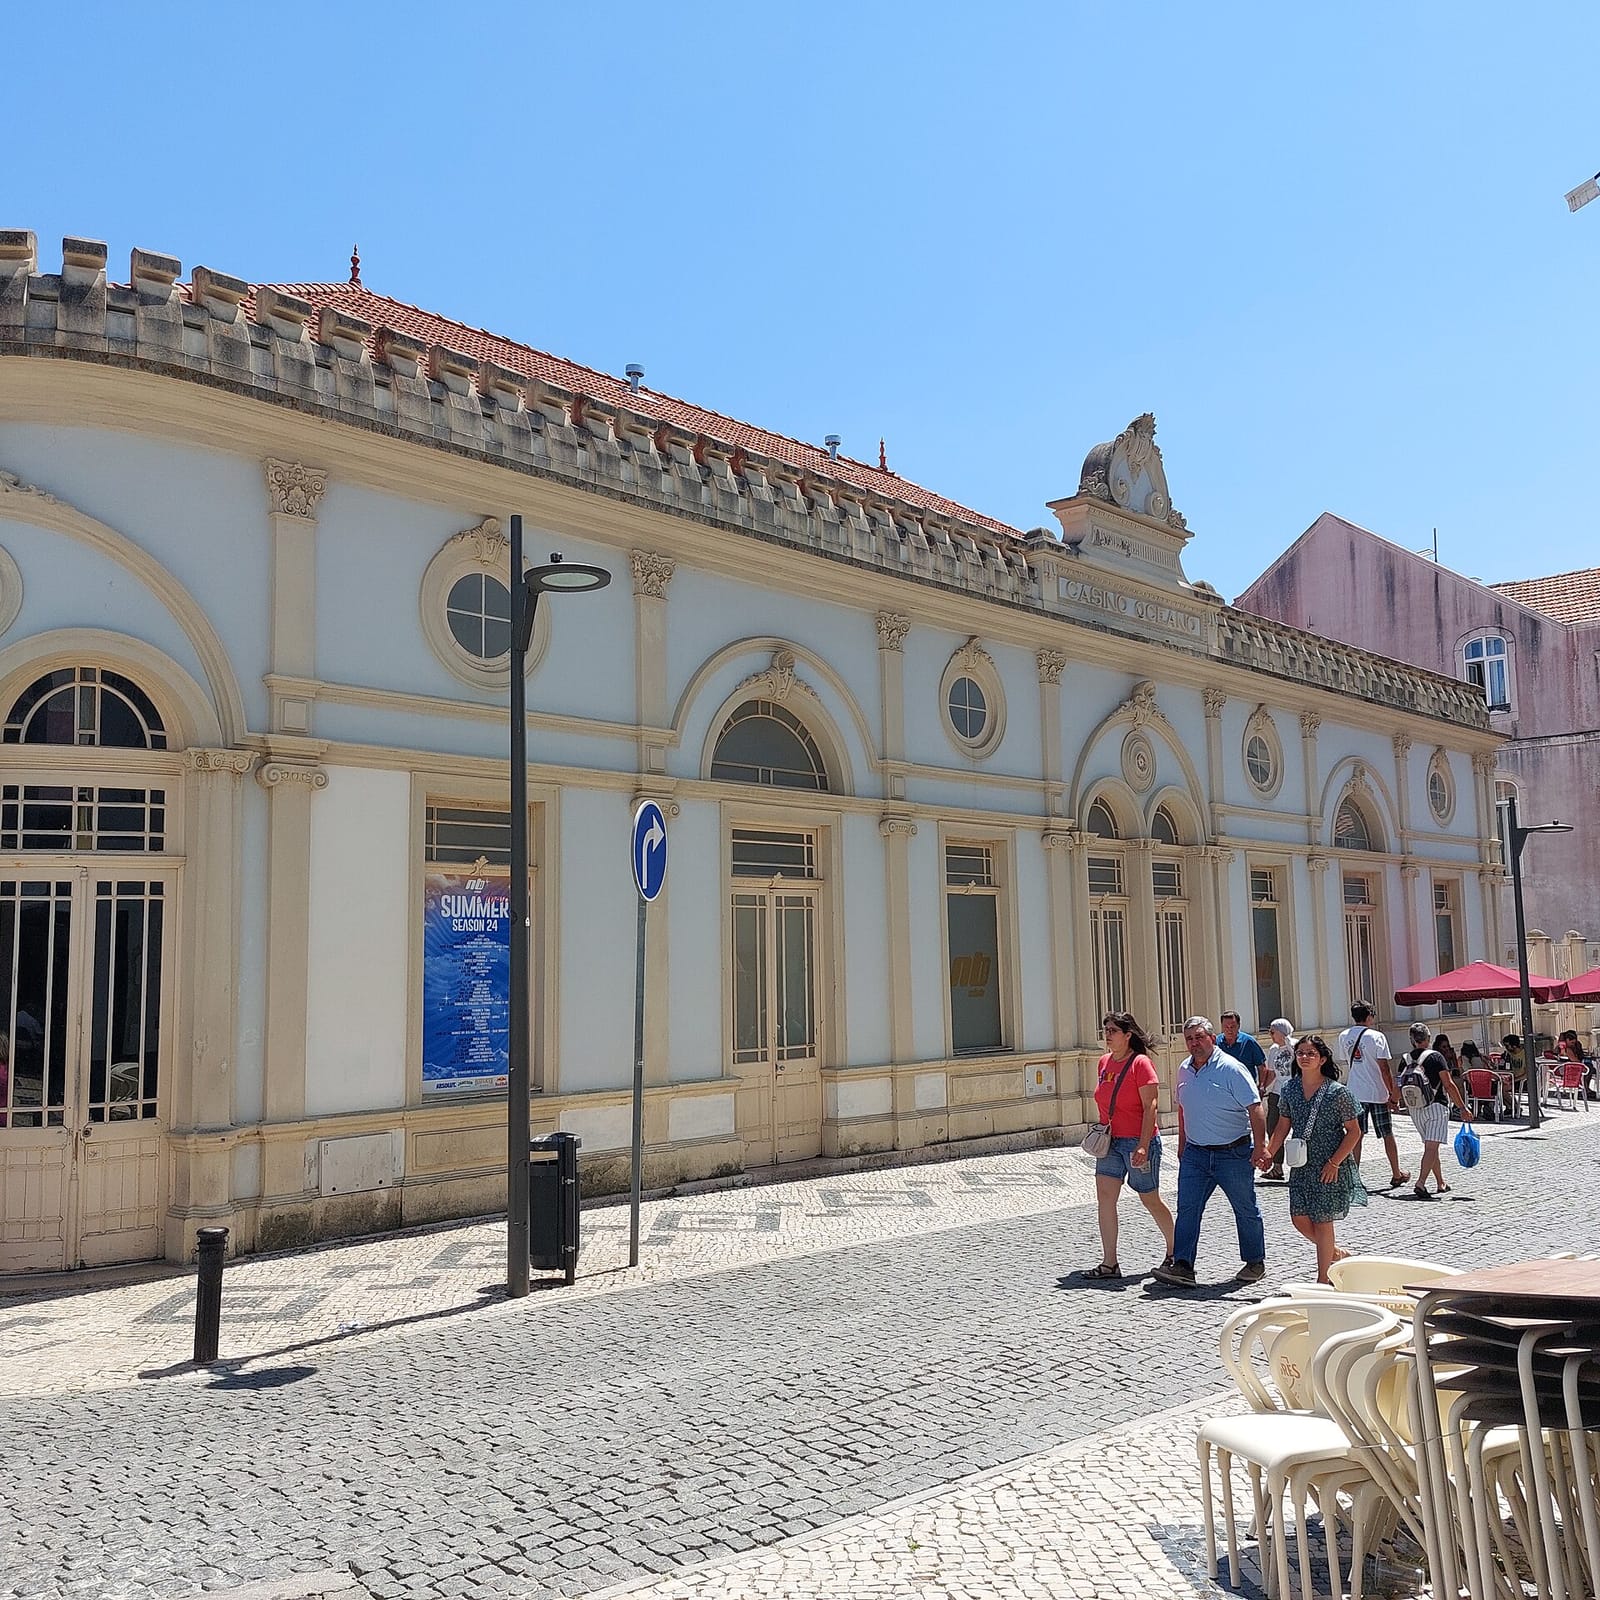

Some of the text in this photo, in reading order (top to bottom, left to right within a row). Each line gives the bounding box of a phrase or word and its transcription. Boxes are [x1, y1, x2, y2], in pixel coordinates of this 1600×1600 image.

[1066, 580, 1196, 631] CASINO OCEANO
[441, 894, 509, 918] SUMMER
[452, 918, 498, 932] SEASON 24
